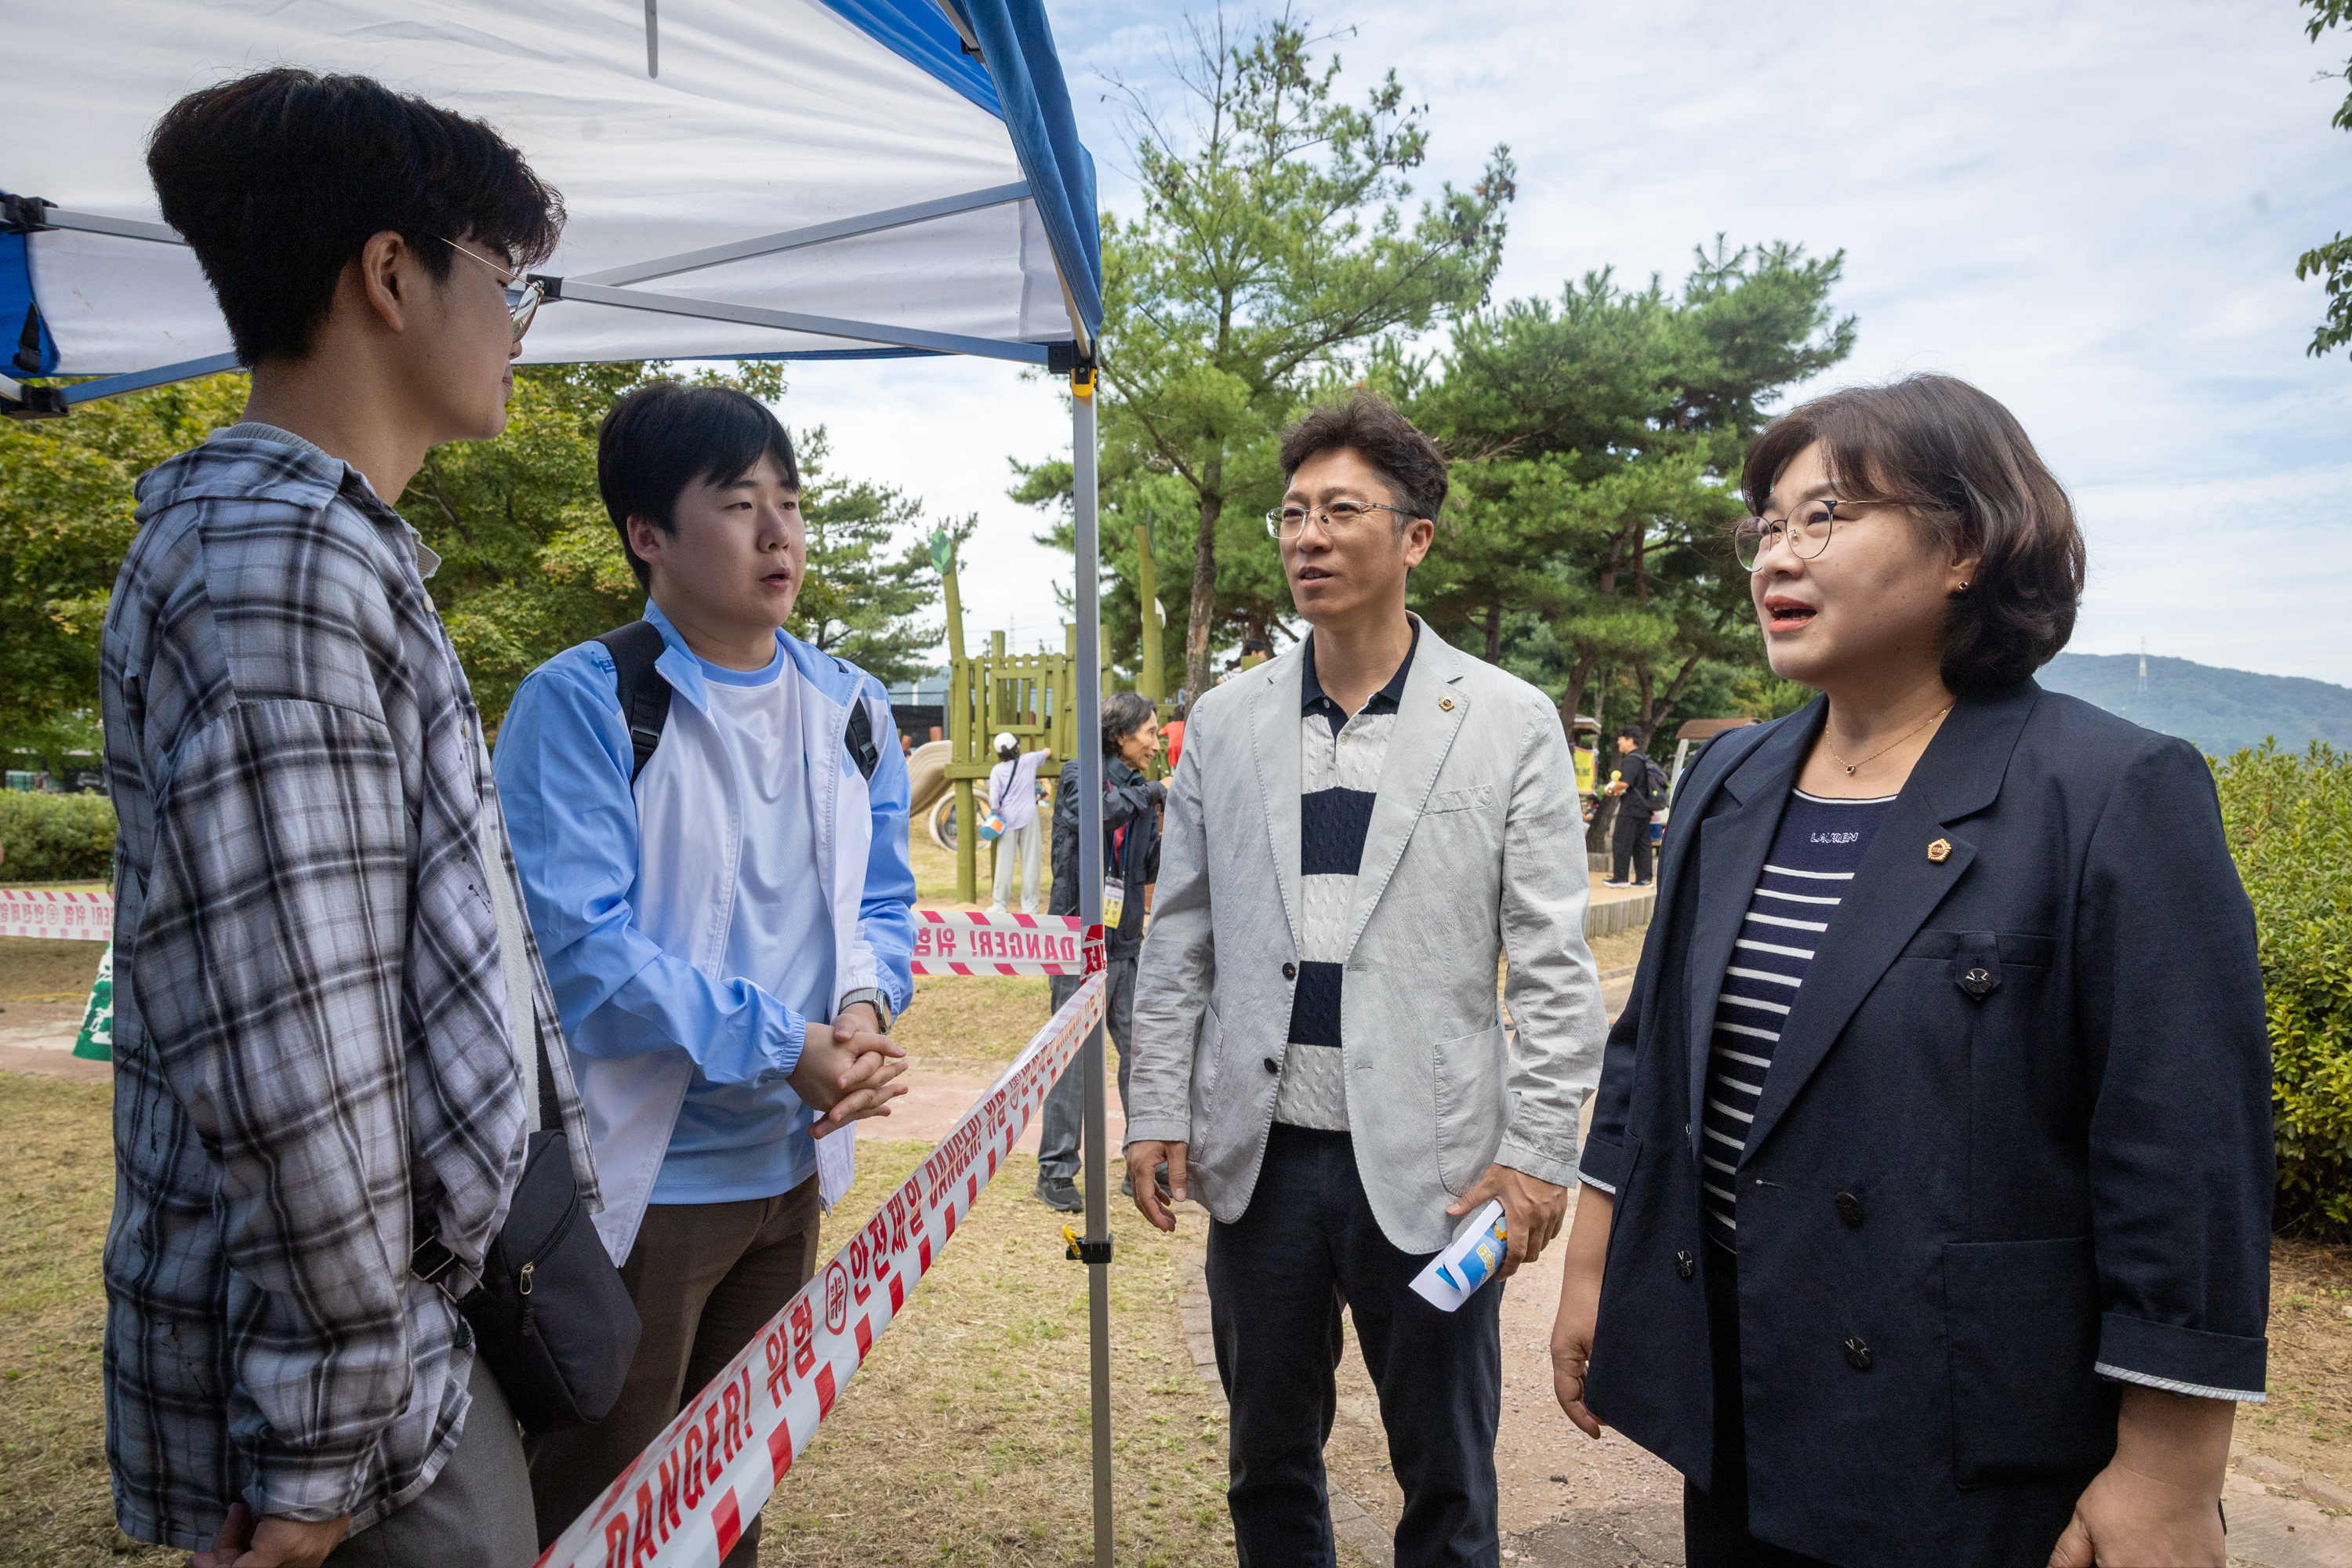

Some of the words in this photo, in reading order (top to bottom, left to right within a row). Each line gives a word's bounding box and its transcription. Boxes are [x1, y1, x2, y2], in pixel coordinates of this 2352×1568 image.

[1810, 832, 1859, 844] LAUREN
[849, 1174, 924, 1307] 안전제일
[924, 1113, 982, 1210] DANGER!
[604, 1364, 753, 1568] DANGER!
[765, 1294, 817, 1410] 위험
